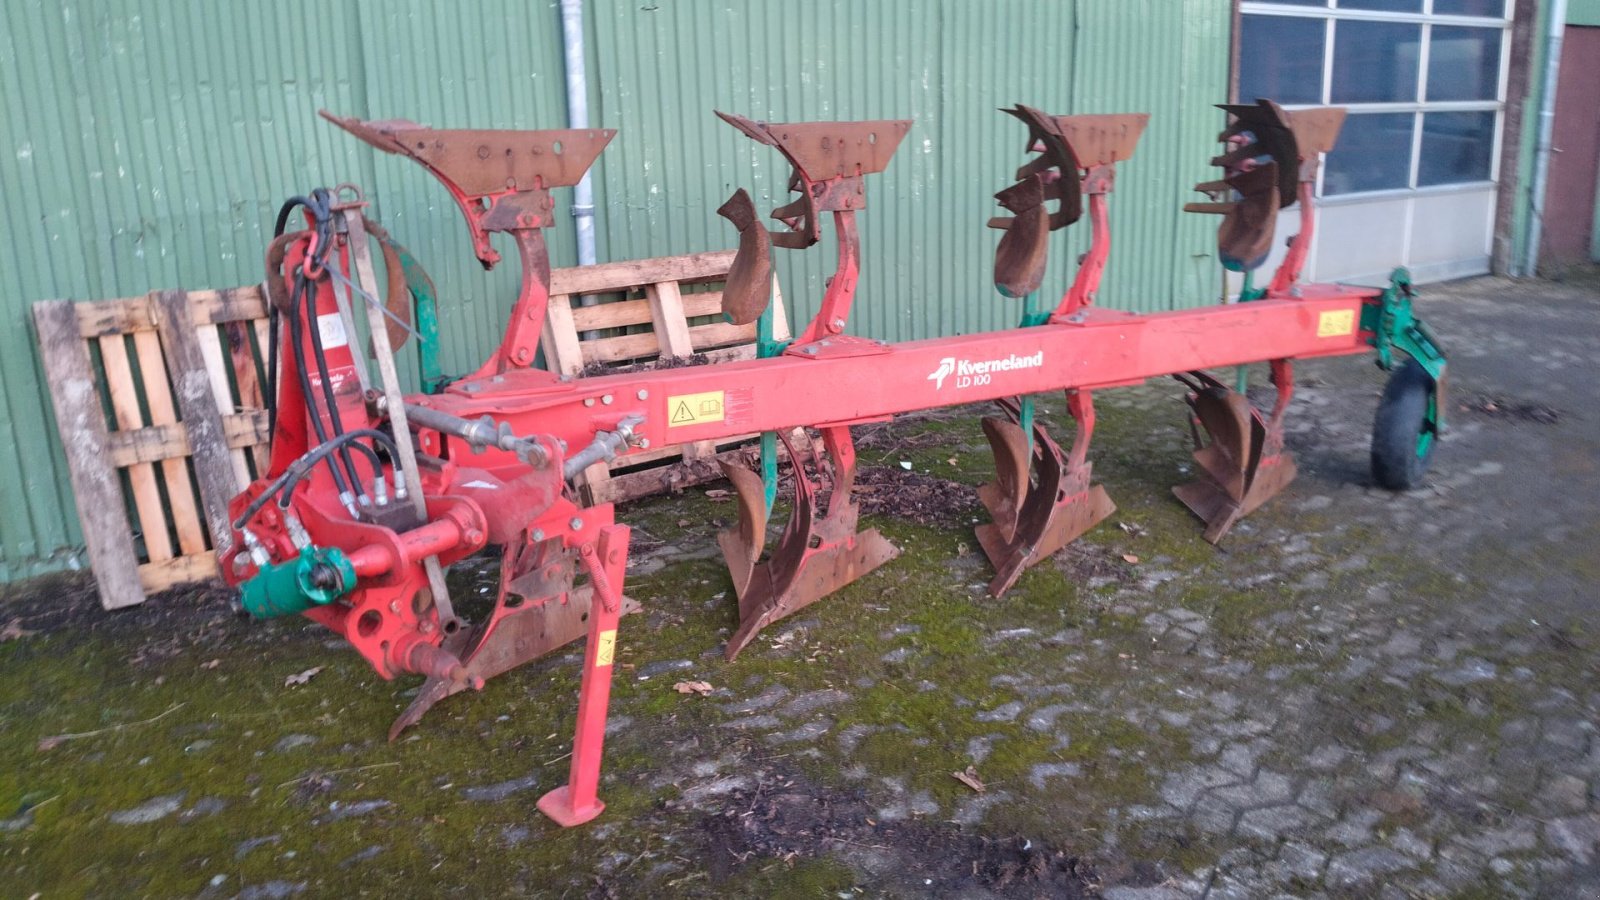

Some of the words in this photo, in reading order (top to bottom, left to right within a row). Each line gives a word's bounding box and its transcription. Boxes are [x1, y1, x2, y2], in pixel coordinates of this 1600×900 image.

[957, 350, 1043, 376] Kverneland
[956, 376, 971, 388] LD
[973, 374, 991, 386] 100
